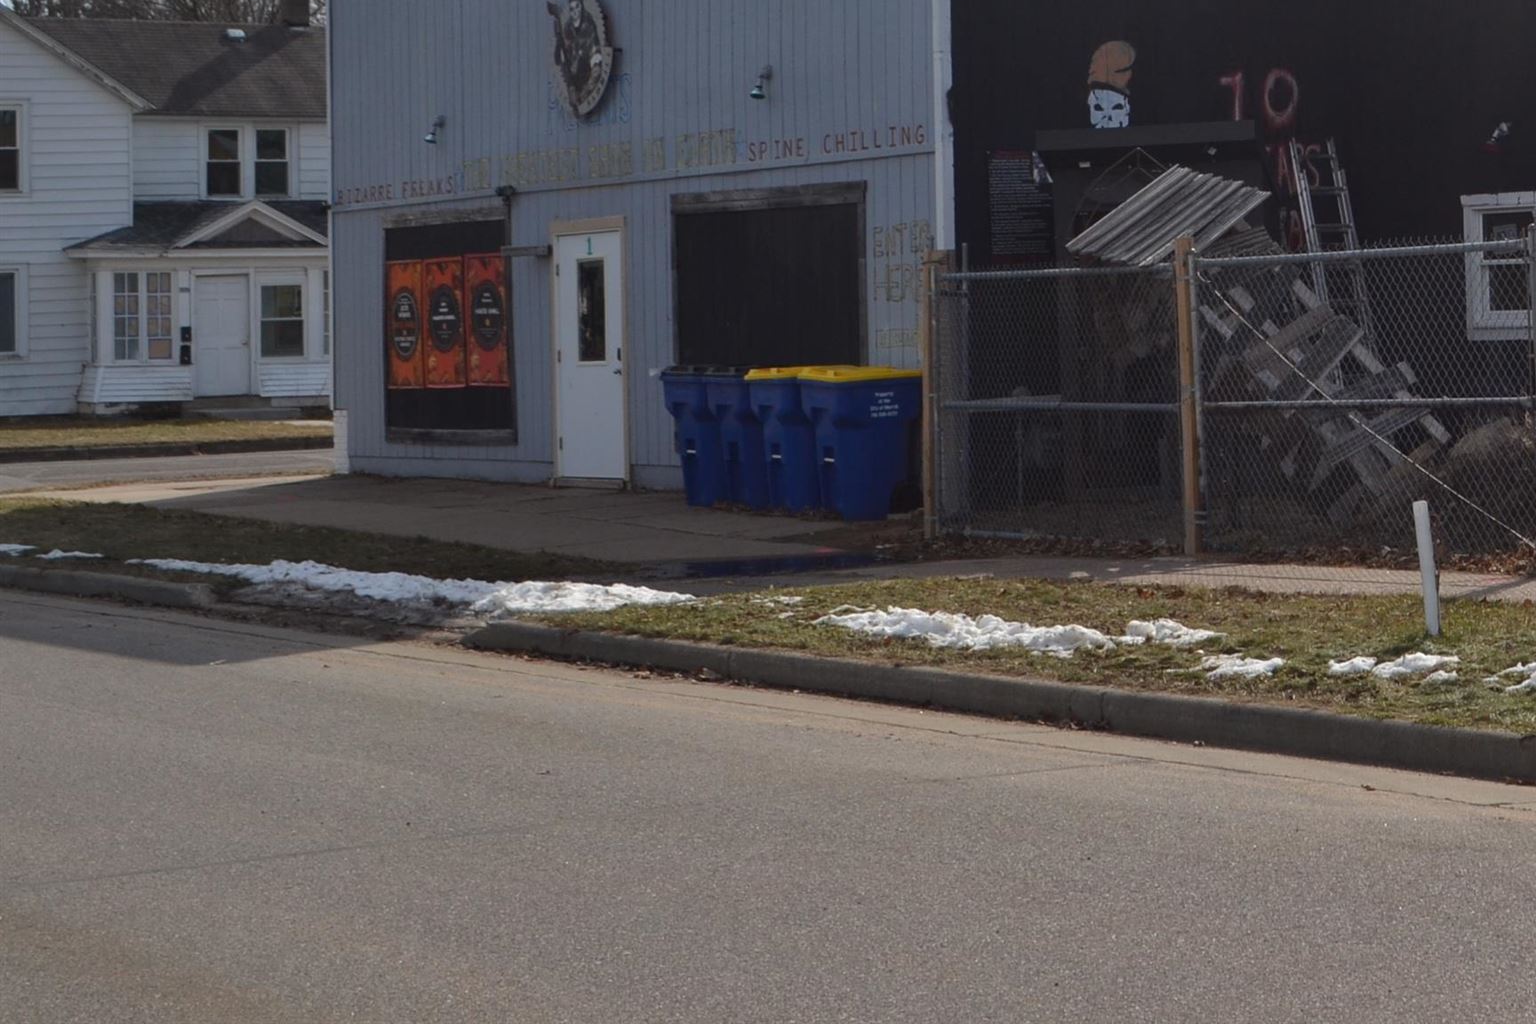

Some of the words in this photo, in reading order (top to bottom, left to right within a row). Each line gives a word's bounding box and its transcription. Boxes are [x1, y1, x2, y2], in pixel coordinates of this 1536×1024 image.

[747, 138, 805, 163] SPINE
[823, 124, 926, 154] CHILLING
[336, 183, 393, 205] BIZARRE
[402, 175, 454, 200] FREAKS
